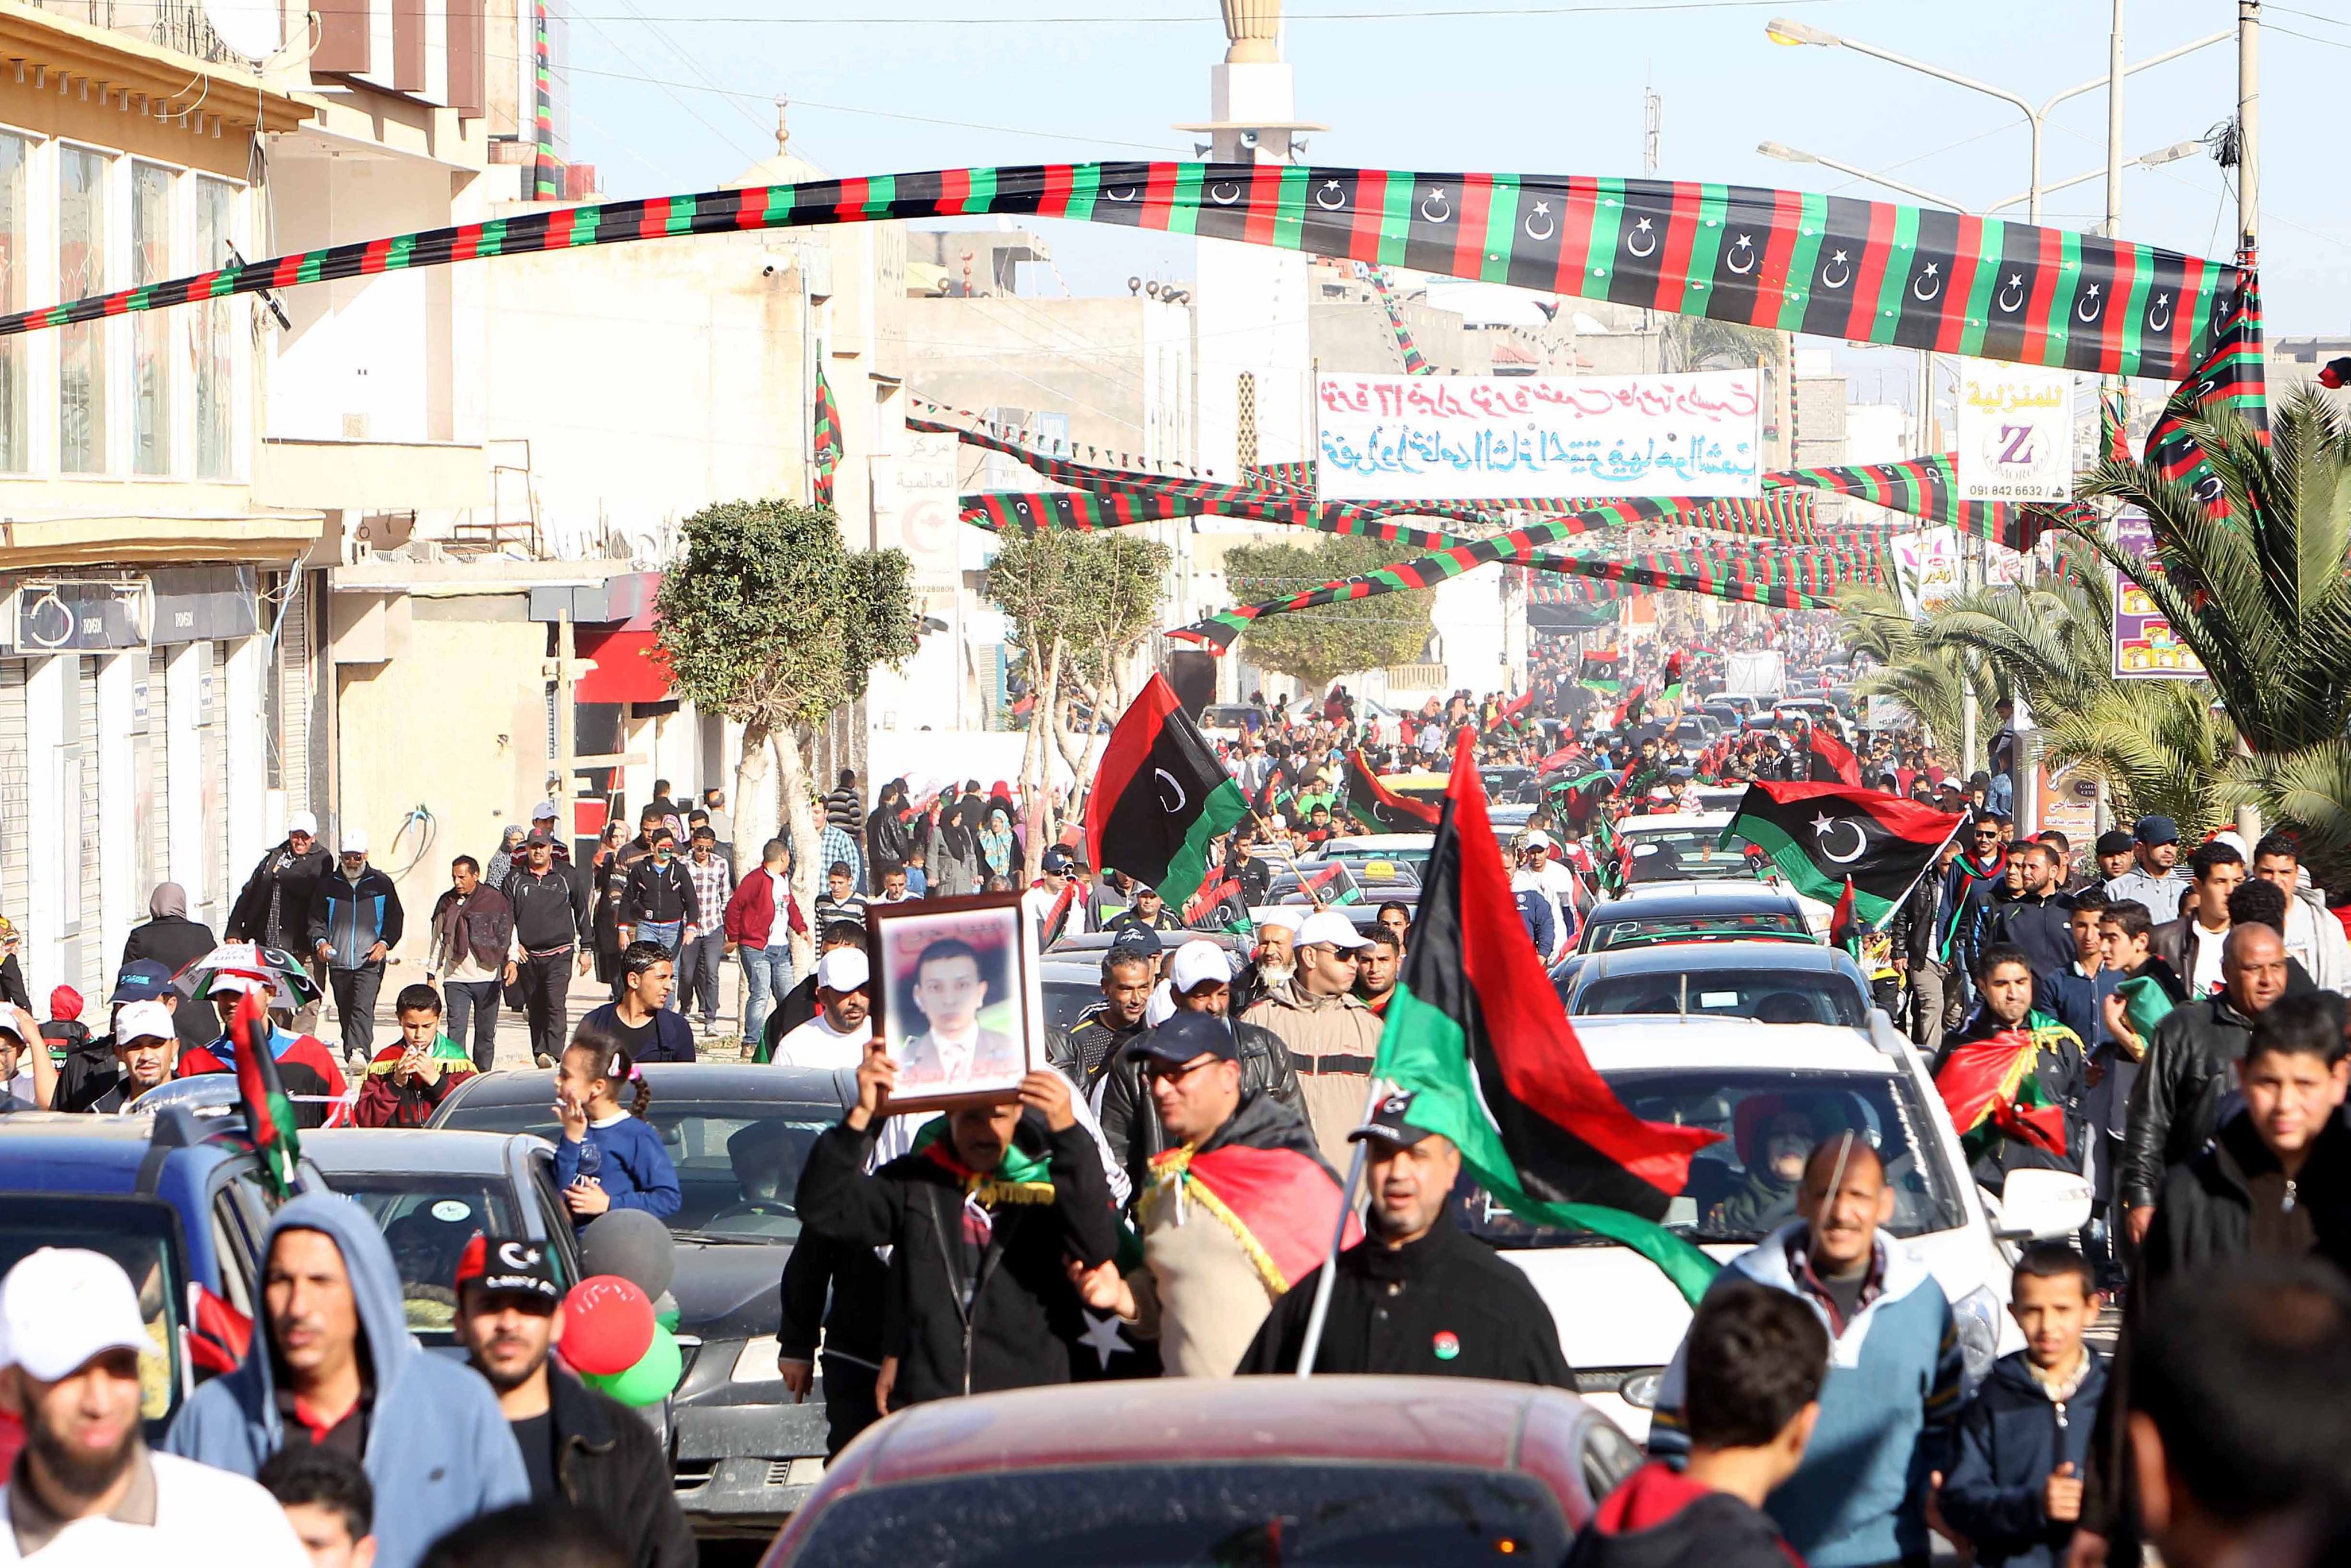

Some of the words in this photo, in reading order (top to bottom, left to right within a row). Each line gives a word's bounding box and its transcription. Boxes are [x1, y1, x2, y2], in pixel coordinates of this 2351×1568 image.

[903, 437, 950, 457] مركز
[1998, 423, 2034, 464] Z
[1969, 486, 1988, 495] 091
[1992, 486, 2012, 496] 842
[2015, 486, 2042, 496] 6632
